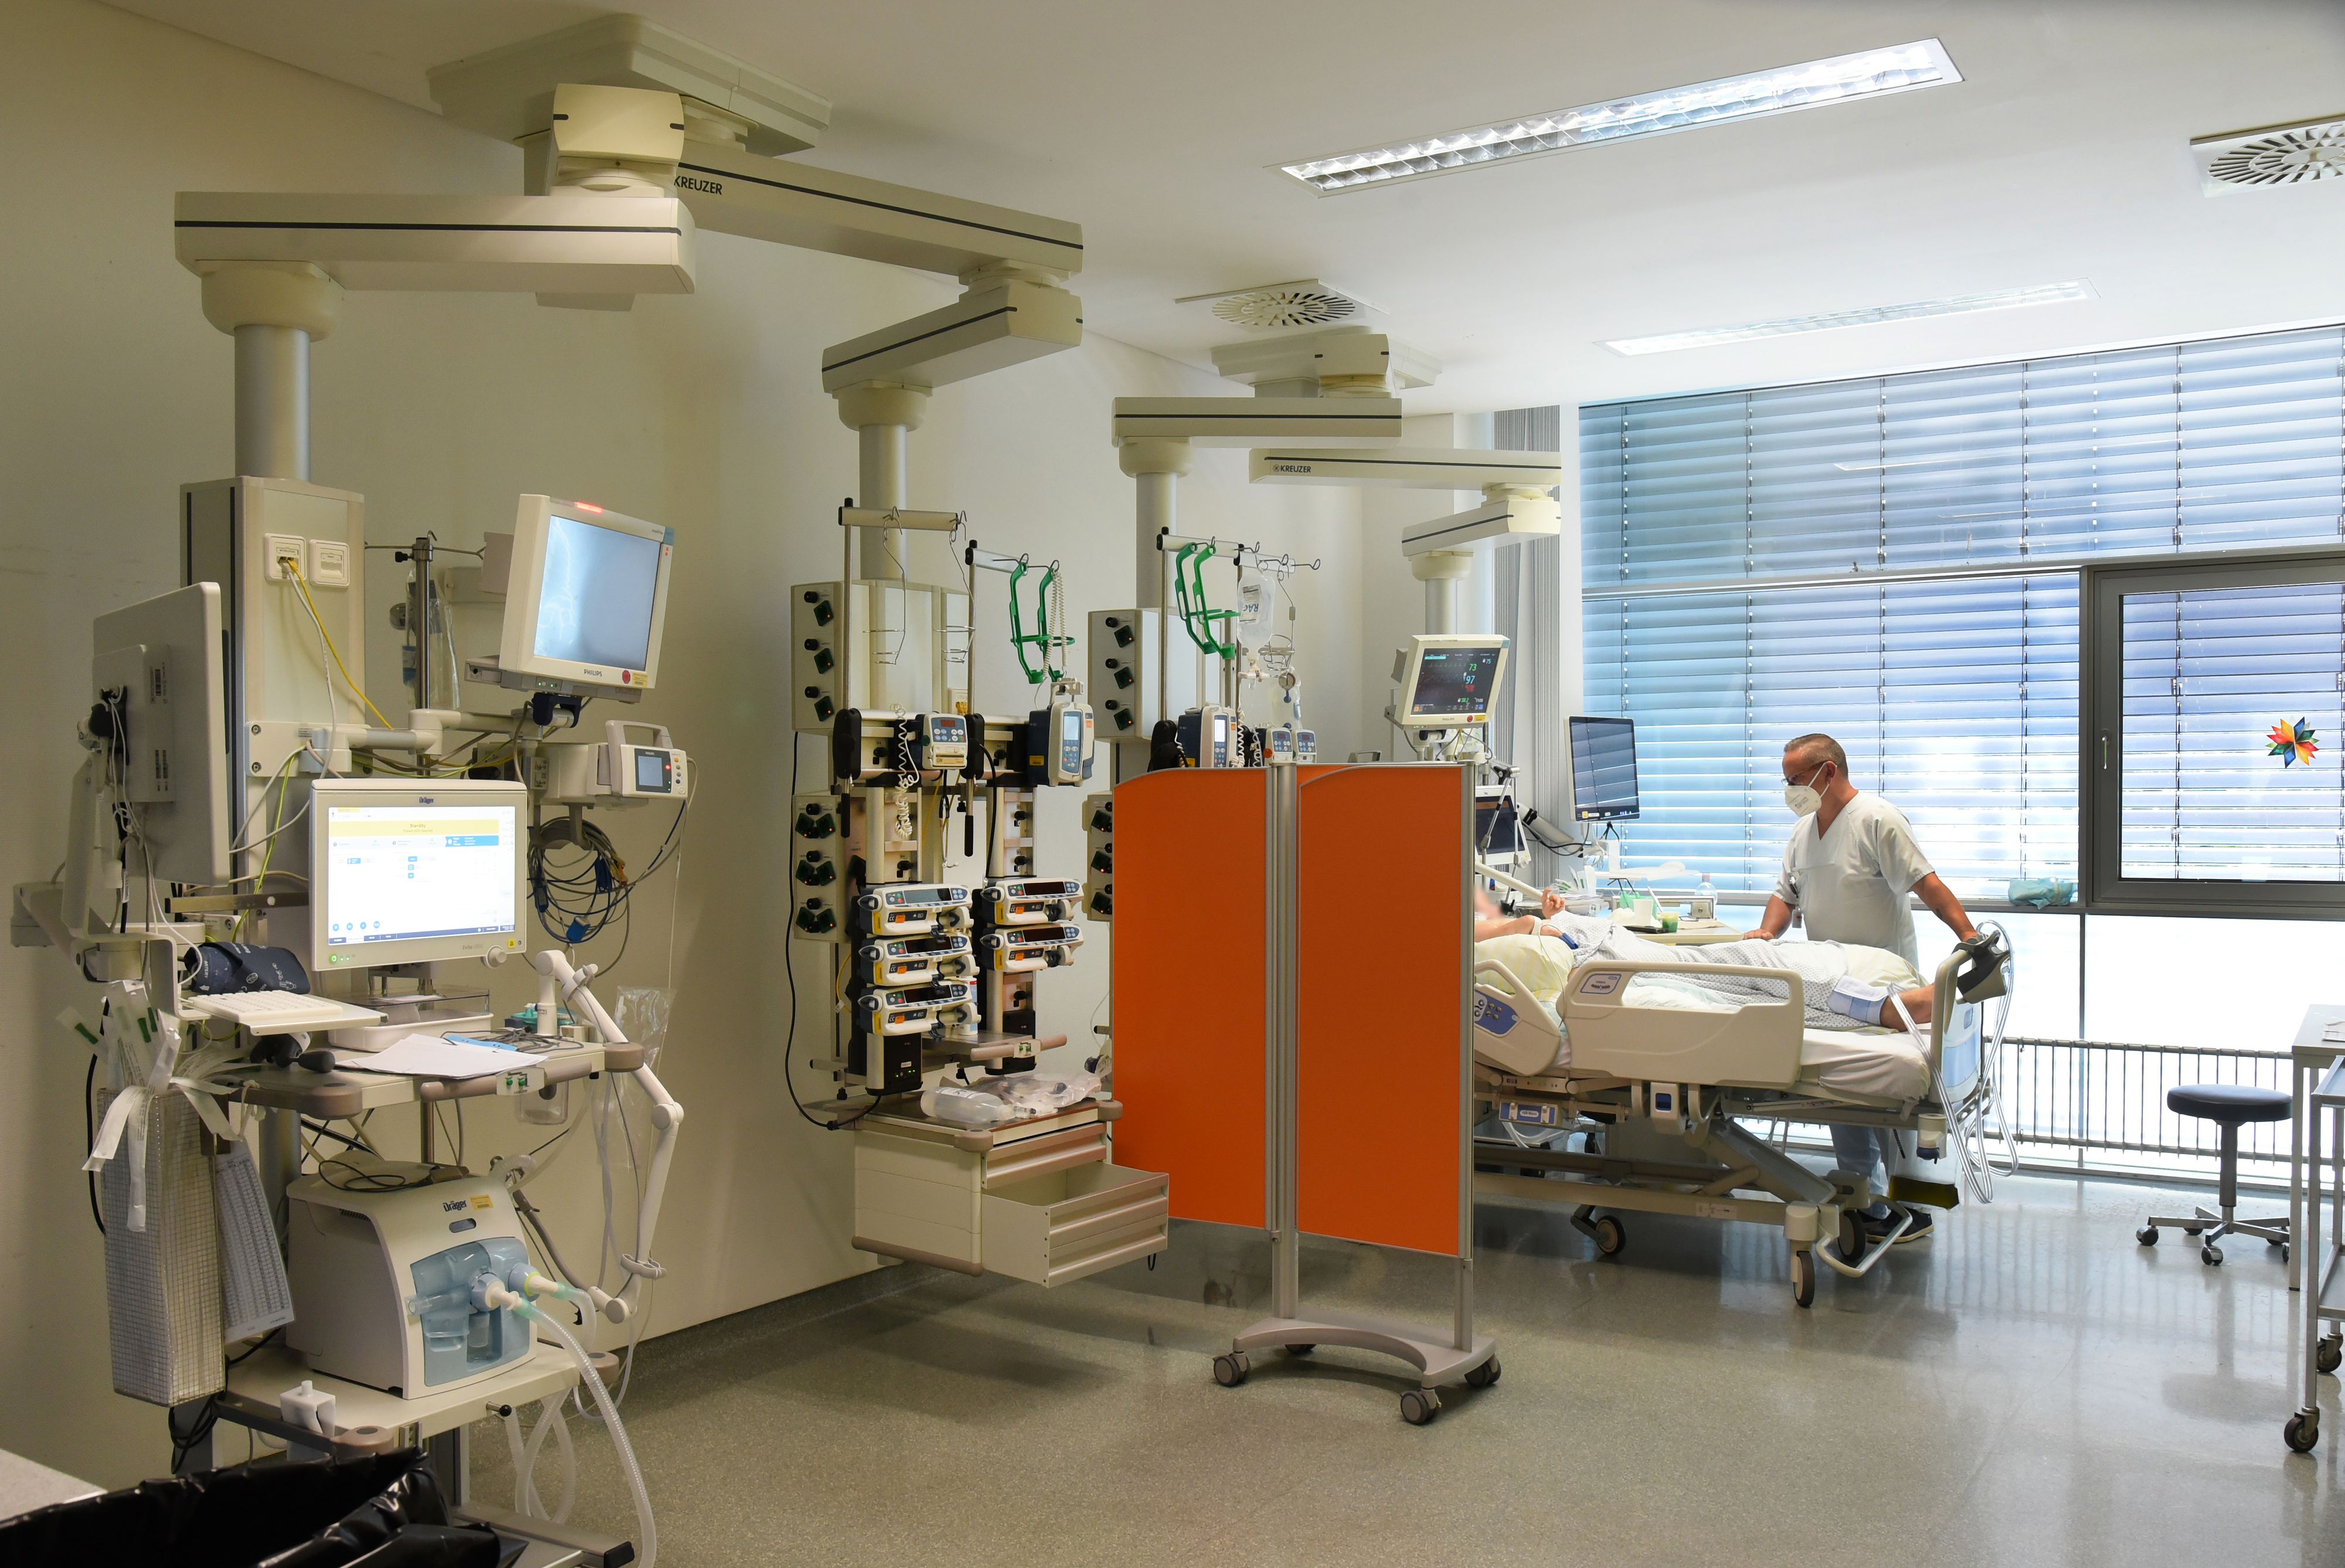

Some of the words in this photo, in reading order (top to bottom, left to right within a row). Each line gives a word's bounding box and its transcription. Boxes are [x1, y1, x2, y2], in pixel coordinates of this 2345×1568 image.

[674, 176, 722, 195] KREUZER
[1469, 663, 1477, 671] 73
[1466, 675, 1475, 684] 97
[419, 797, 434, 805] Dräger
[442, 1200, 467, 1212] Dräger
